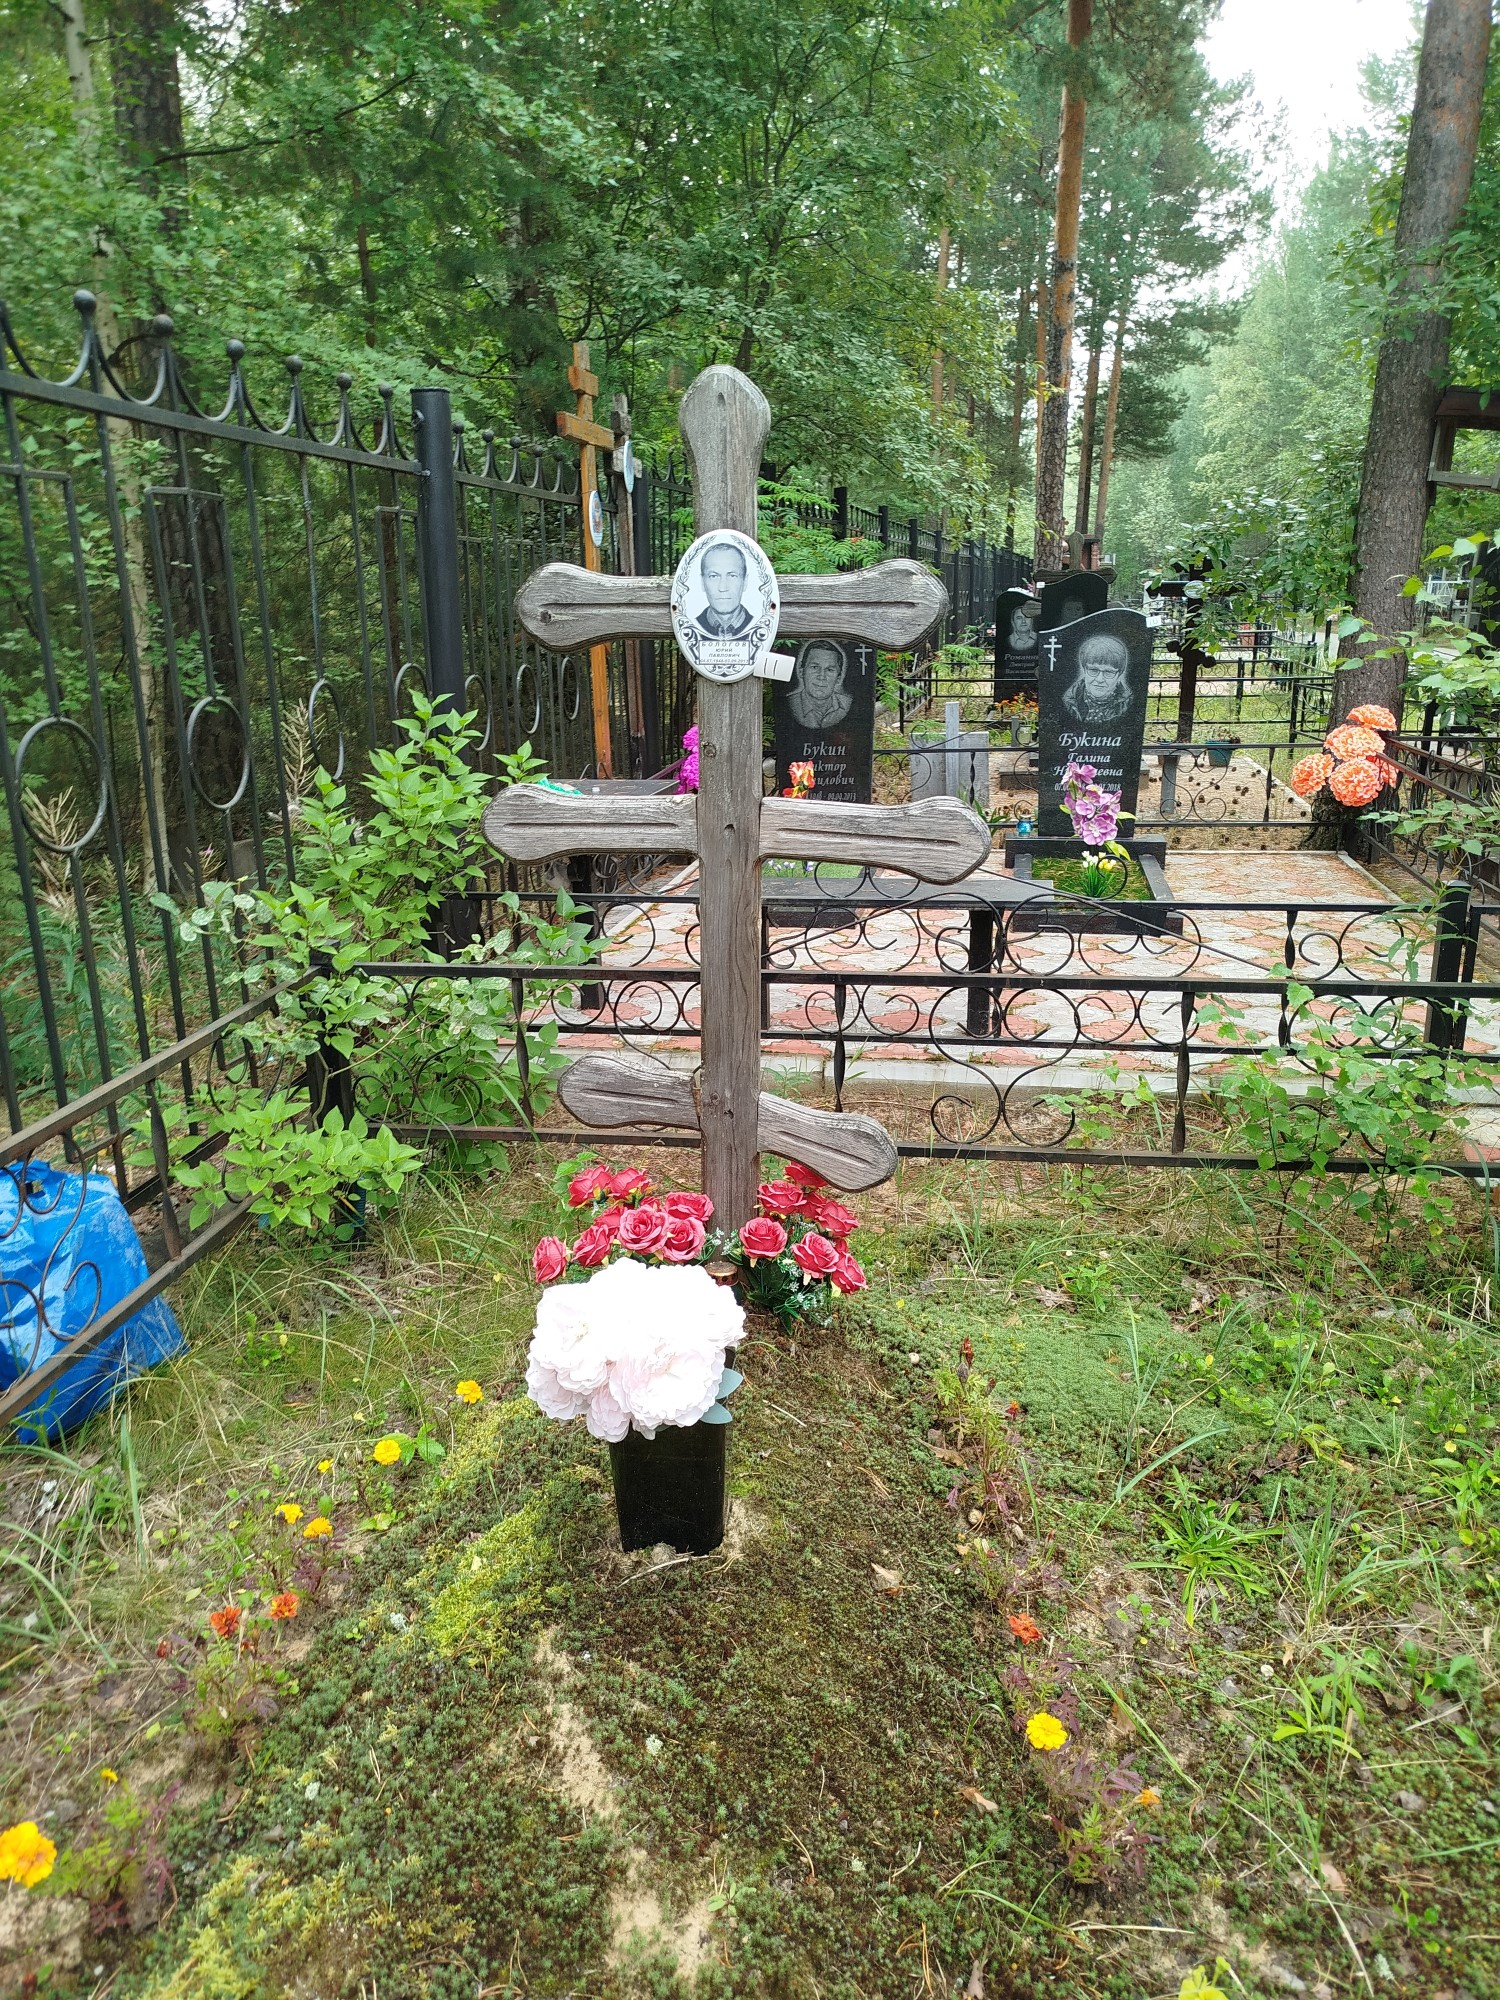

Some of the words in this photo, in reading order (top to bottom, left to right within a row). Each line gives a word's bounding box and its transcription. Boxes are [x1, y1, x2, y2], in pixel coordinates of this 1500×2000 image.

[802, 741, 846, 760] Букин
[1058, 731, 1122, 751] Букина
[1067, 752, 1111, 763] Галина
